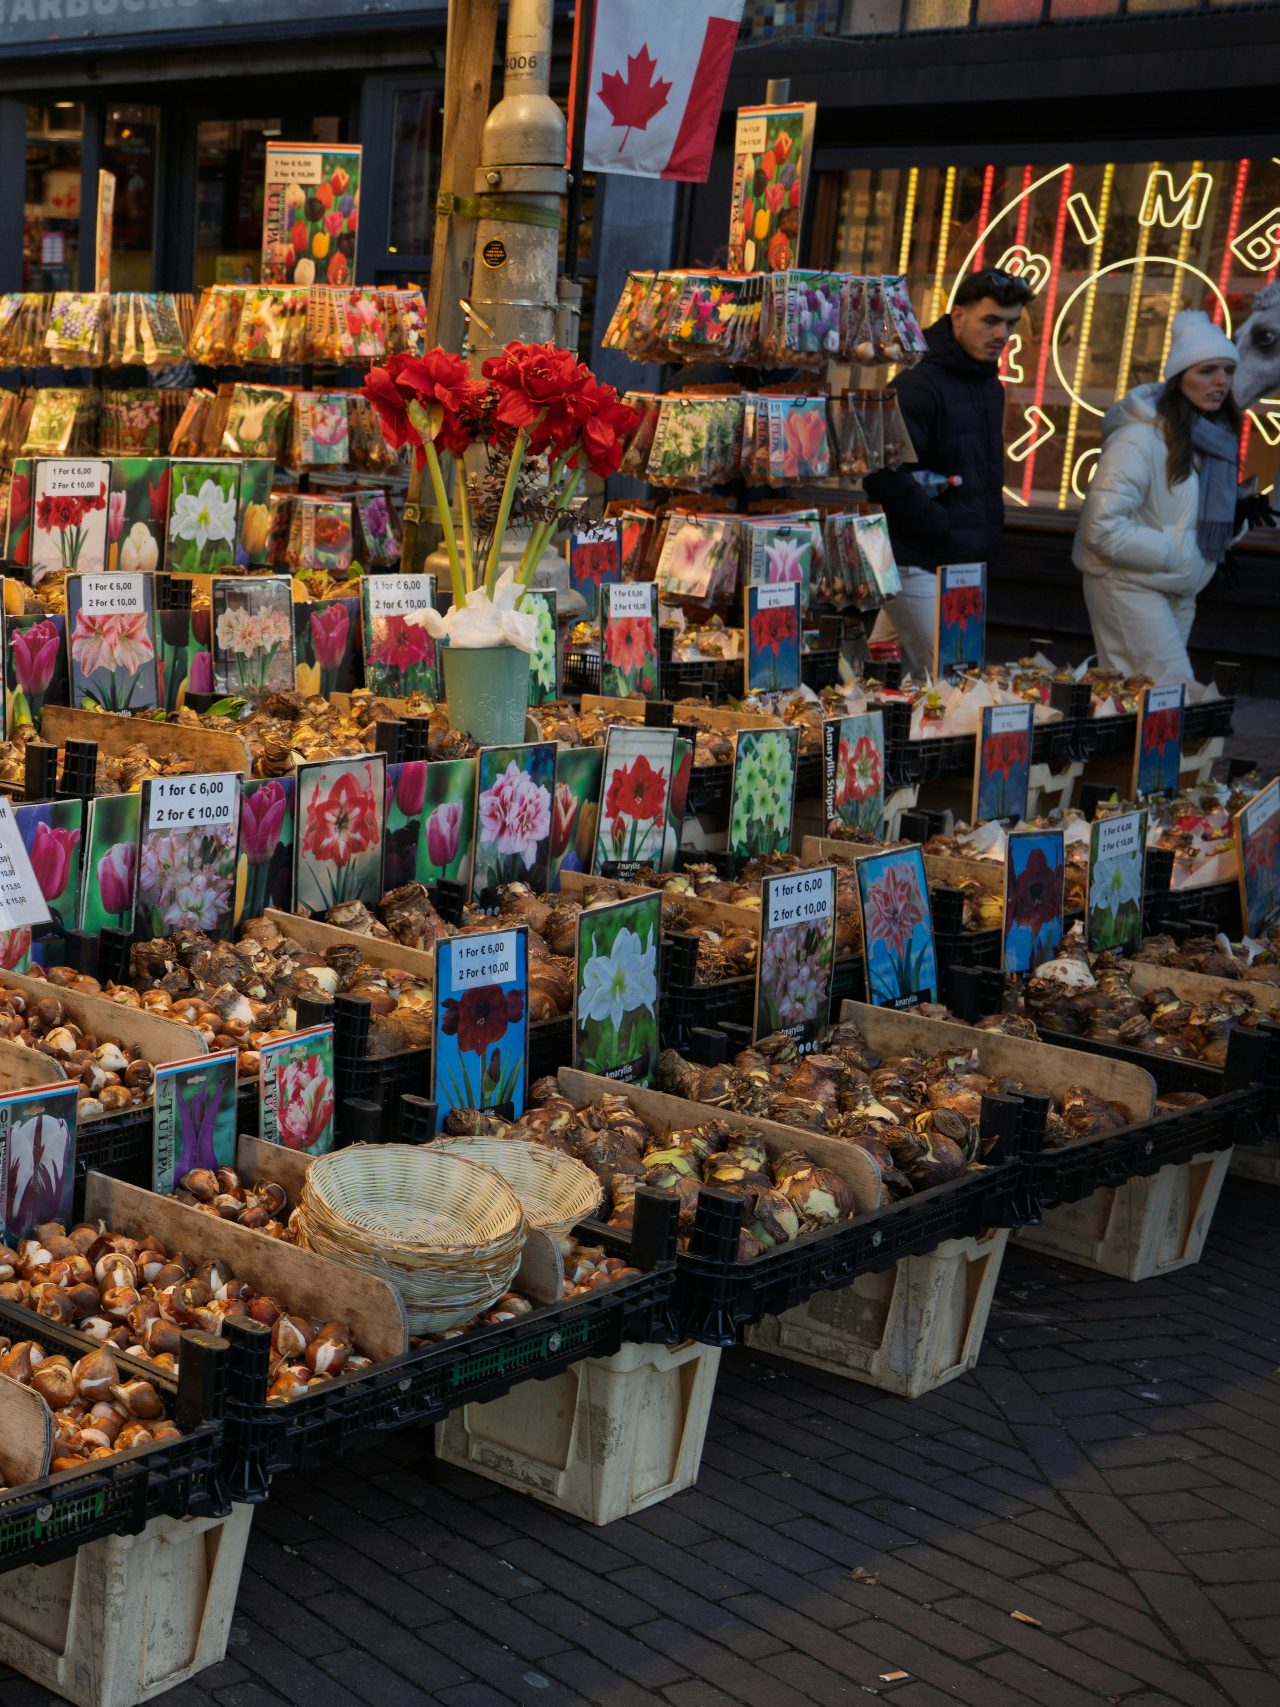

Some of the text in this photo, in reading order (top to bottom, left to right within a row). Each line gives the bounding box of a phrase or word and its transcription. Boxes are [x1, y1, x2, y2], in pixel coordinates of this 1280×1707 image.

[116, 583, 132, 591] 6,00
[117, 598, 136, 607] 10,00
[825, 726, 835, 819] Amaryllis Striped
[159, 782, 223, 796] 1 for € 6,00
[156, 806, 229, 821] 2 for € 10,00
[617, 862, 640, 871] Amaryllis
[6, 883, 21, 891] 13,50
[775, 878, 822, 897] 1 for € 6,00
[11, 896, 27, 905] 15,00
[773, 900, 827, 921] 2 for € 10,00
[458, 942, 504, 959] 1 For € 6,00
[459, 961, 509, 980] 2 For € 10,00
[605, 1065, 633, 1078] Amaryllis
[158, 1098, 173, 1177] TULIPA
